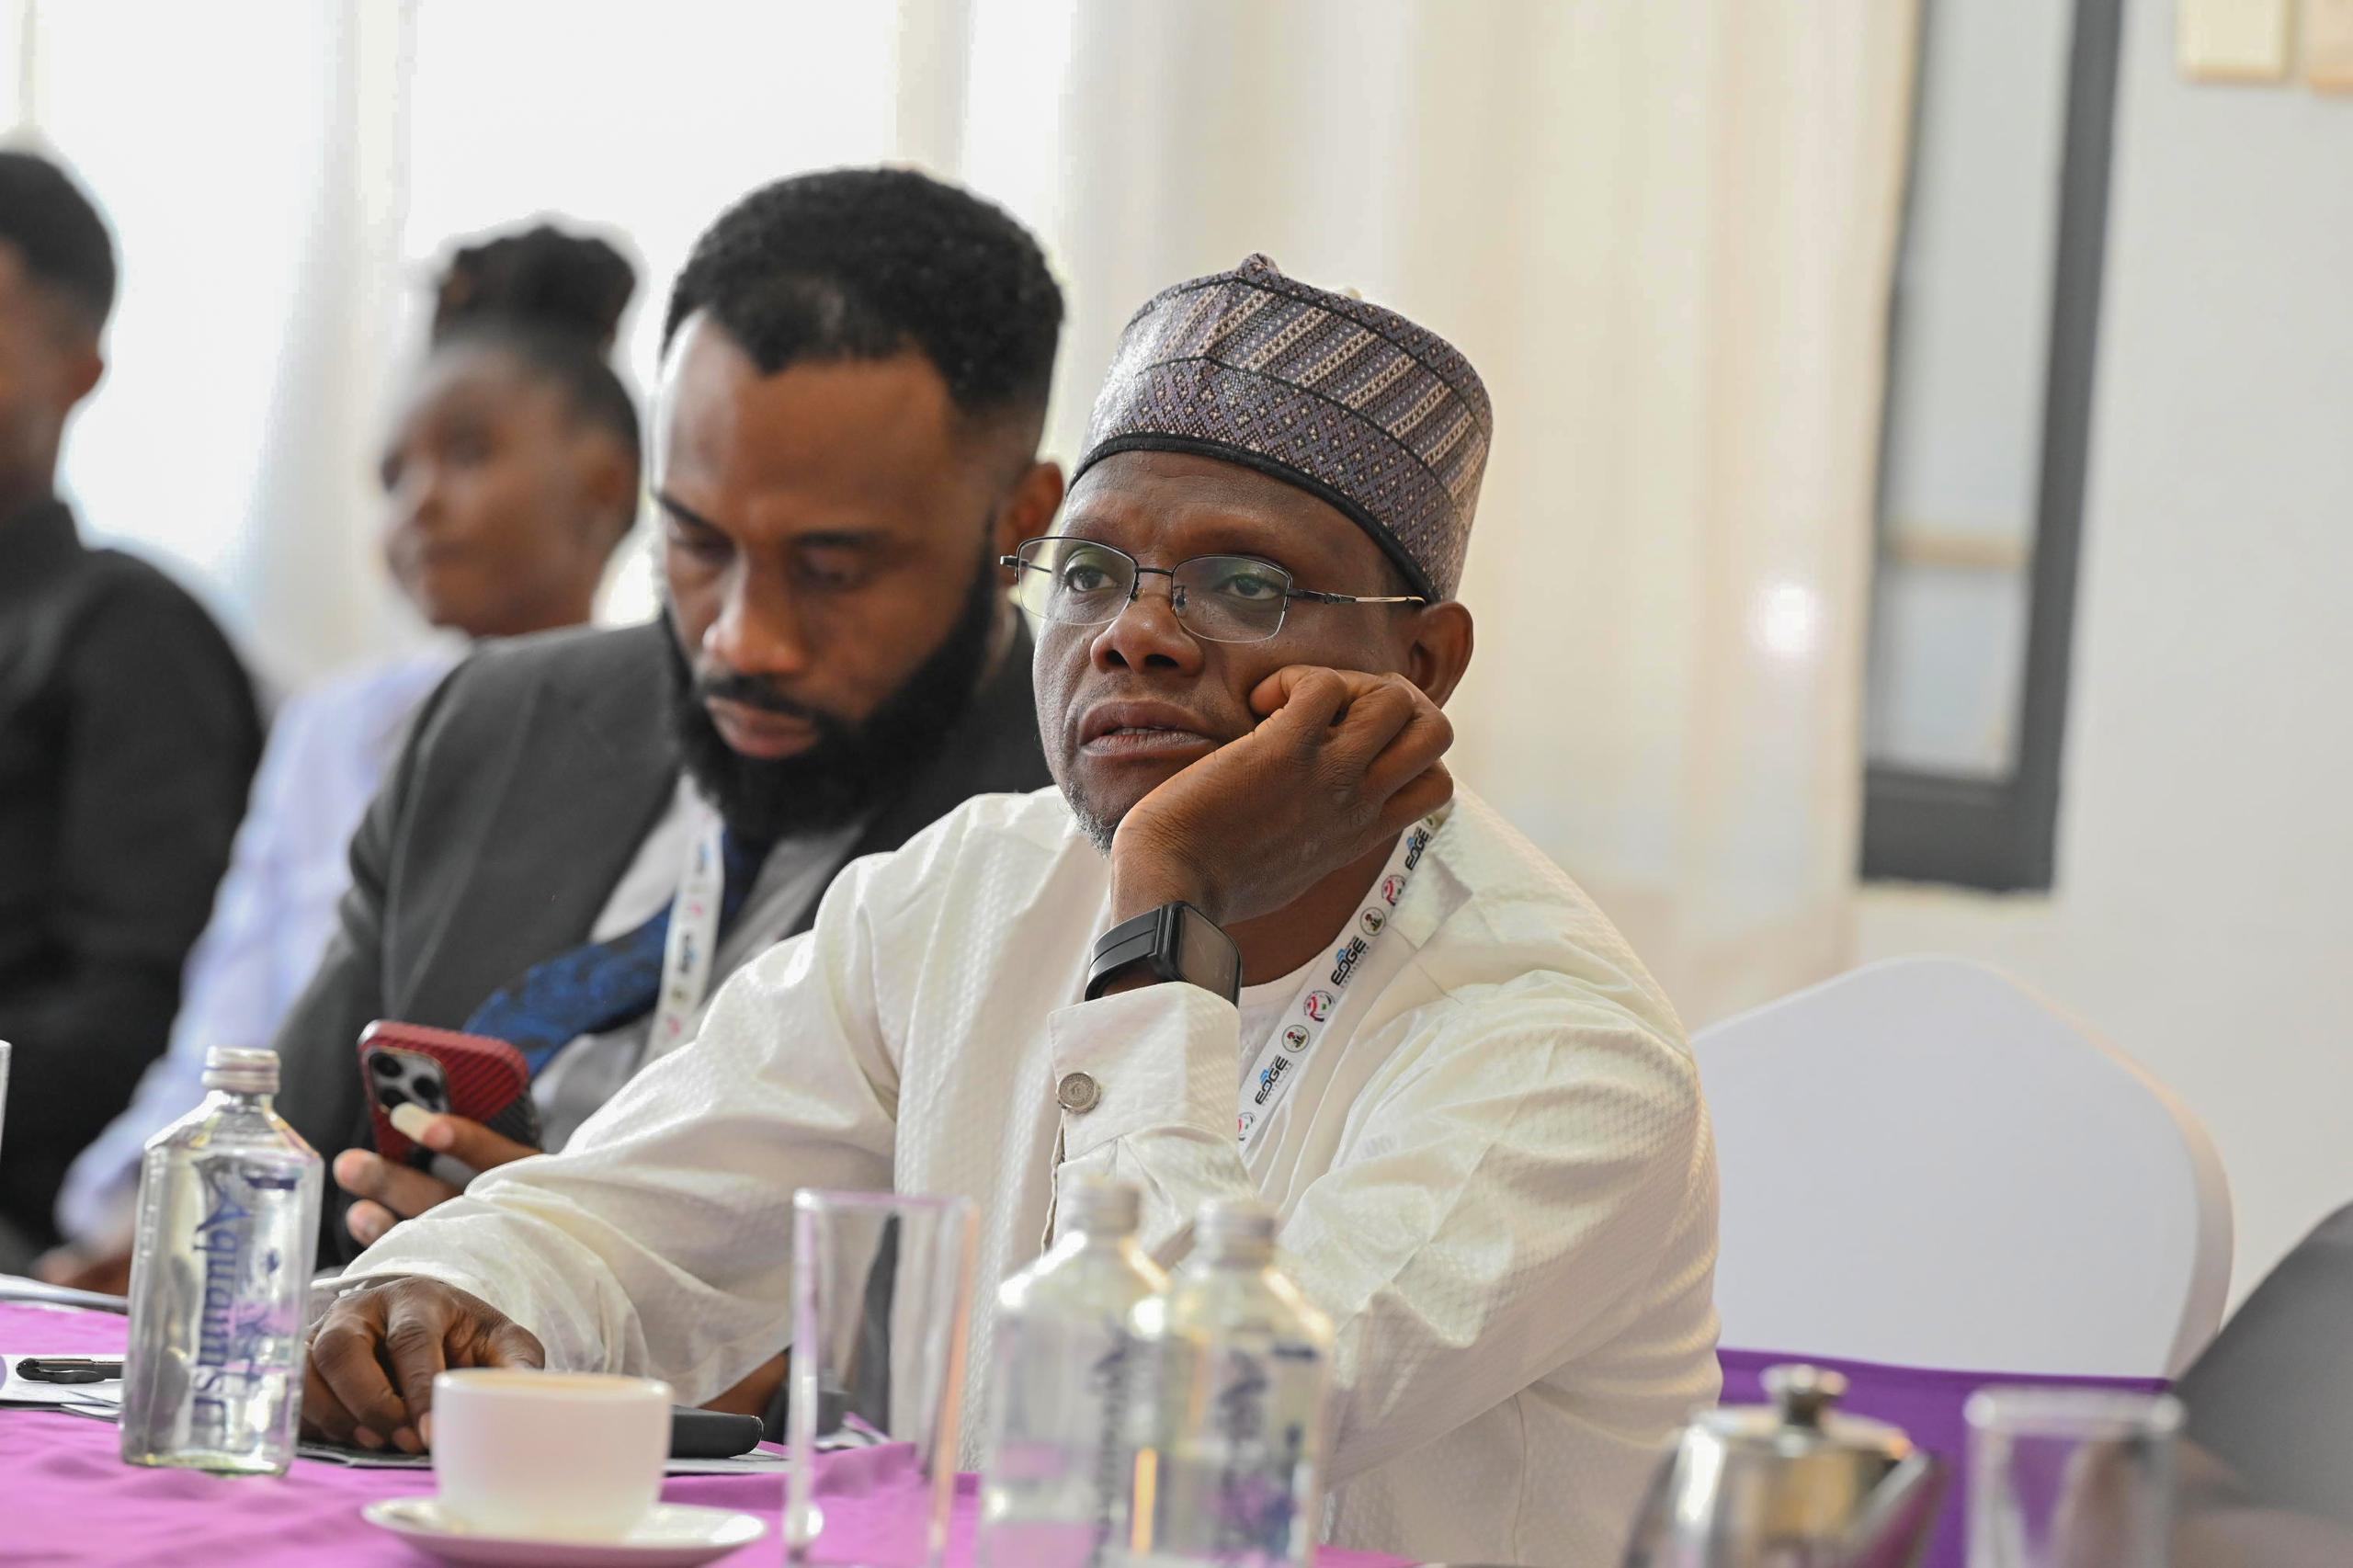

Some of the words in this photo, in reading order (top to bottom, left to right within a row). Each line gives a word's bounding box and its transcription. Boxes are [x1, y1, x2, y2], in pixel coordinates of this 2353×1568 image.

[1404, 829, 1430, 870] EDGE
[1330, 937, 1367, 986] EDGE
[1255, 1056, 1289, 1106] EDGE
